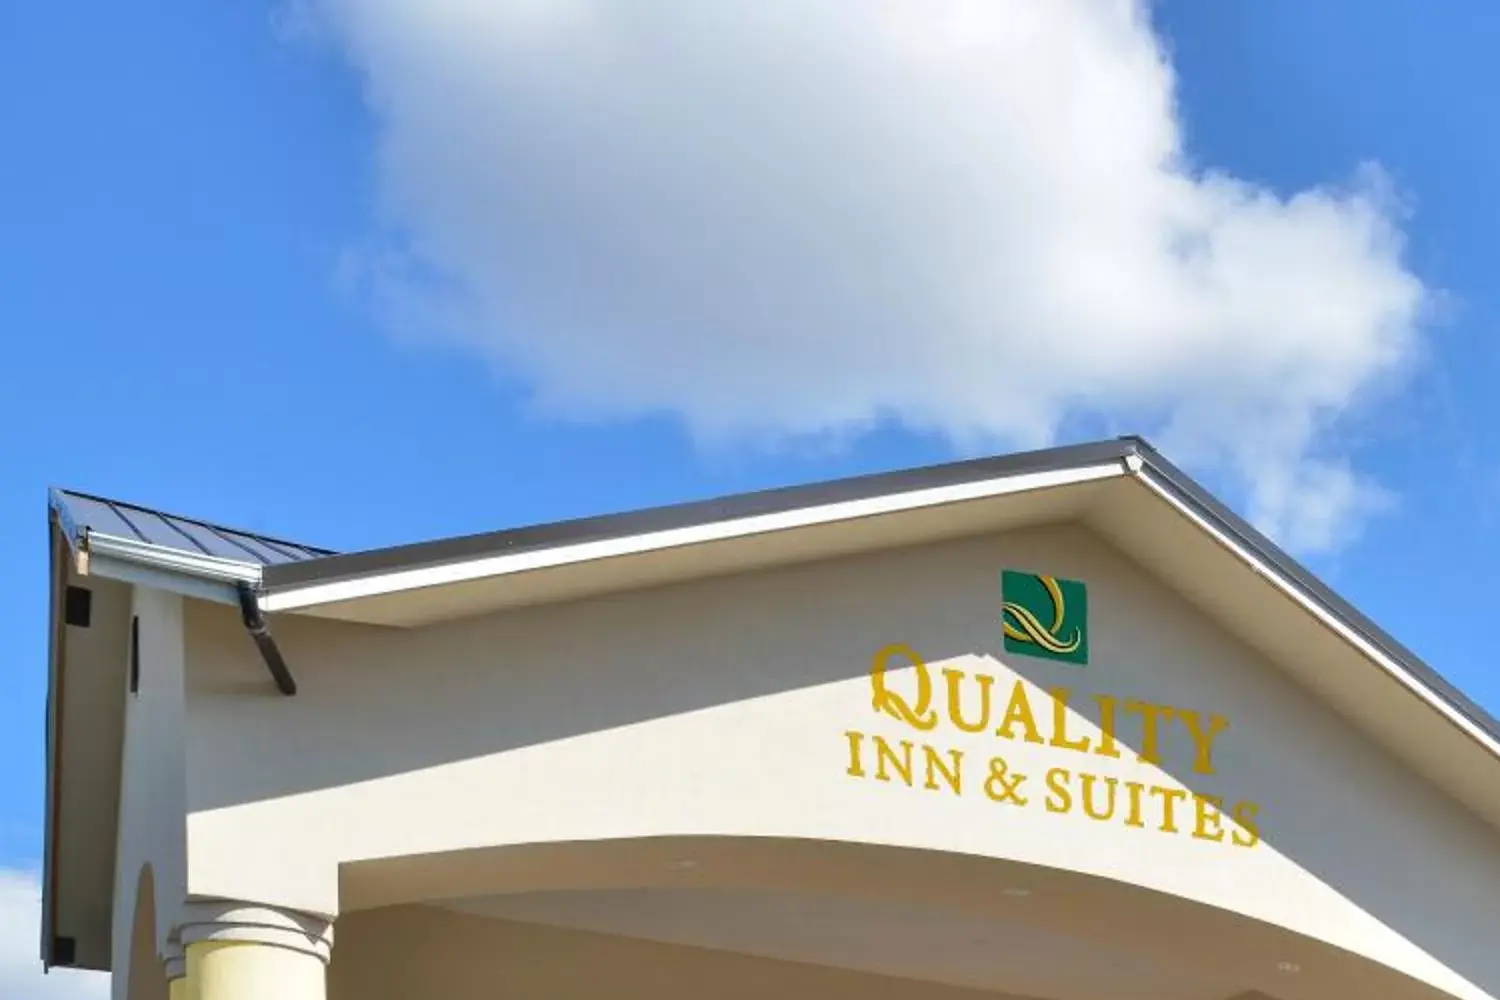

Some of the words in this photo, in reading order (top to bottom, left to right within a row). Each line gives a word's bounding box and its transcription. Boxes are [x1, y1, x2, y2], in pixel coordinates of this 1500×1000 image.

[870, 643, 1229, 775] QUALITY
[844, 731, 965, 795] INN
[983, 757, 1028, 807] &
[1045, 767, 1260, 848] SUITES
